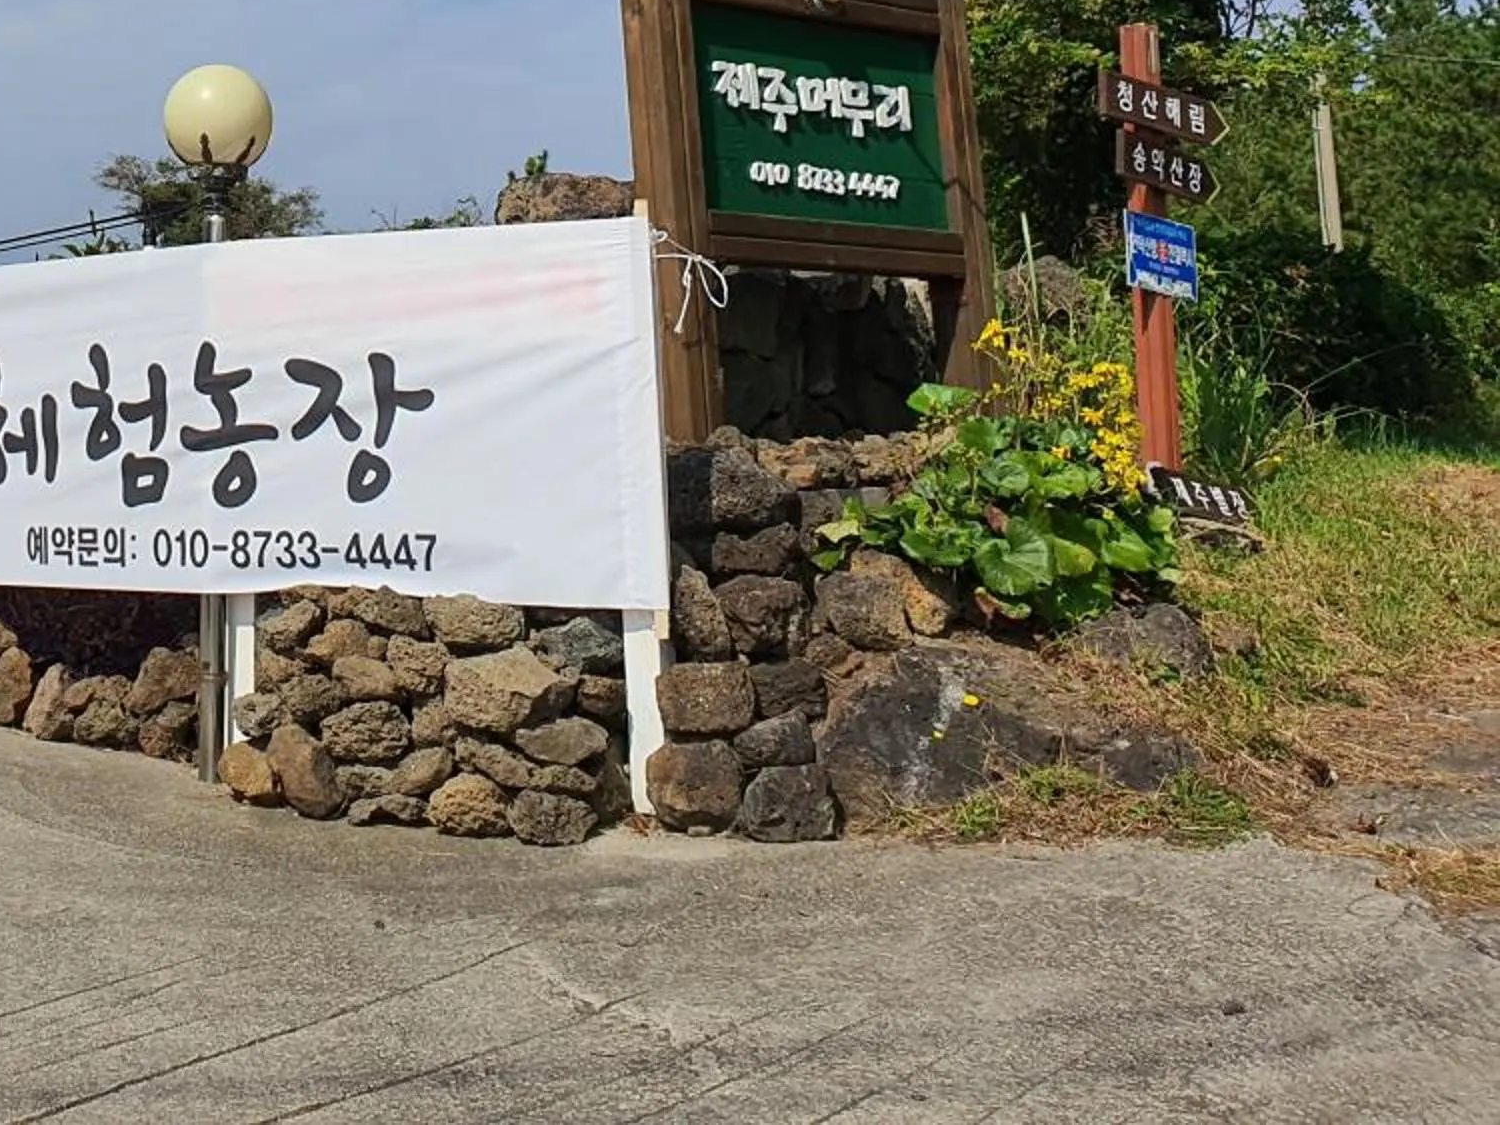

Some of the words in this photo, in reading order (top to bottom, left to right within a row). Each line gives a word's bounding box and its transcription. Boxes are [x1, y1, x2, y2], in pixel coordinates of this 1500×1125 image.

[711, 60, 912, 138] 제주머무리
[749, 161, 791, 186] 010
[797, 163, 845, 195] 8733
[847, 172, 900, 199] 4447
[1131, 141, 1202, 194] 송악산장
[26, 526, 137, 568] 예약문의:
[153, 528, 437, 572] 010-8733-4447
